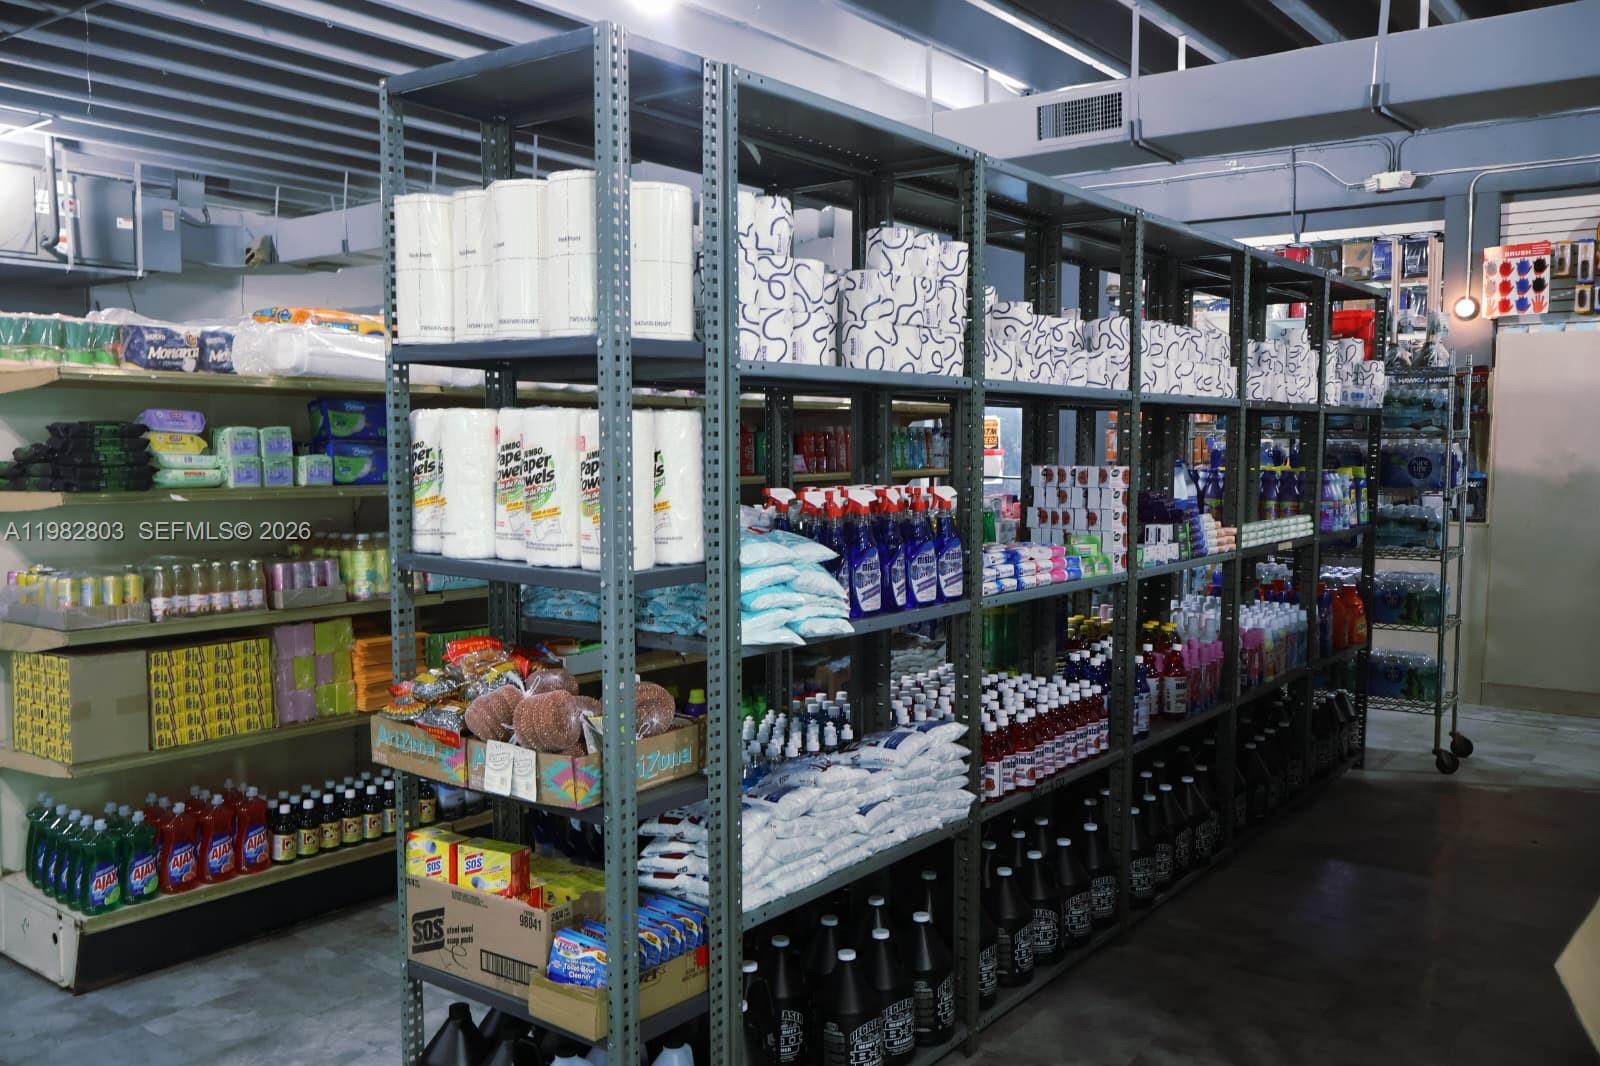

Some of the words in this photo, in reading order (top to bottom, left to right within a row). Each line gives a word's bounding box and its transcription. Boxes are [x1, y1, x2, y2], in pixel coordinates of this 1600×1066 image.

[211, 840, 233, 860] AJAX
[246, 831, 266, 850] AJAX
[172, 848, 195, 869] AJAX
[464, 857, 483, 871] SOS
[94, 868, 118, 891] AJAX
[133, 858, 157, 881] AJAX
[519, 914, 542, 932] 98041
